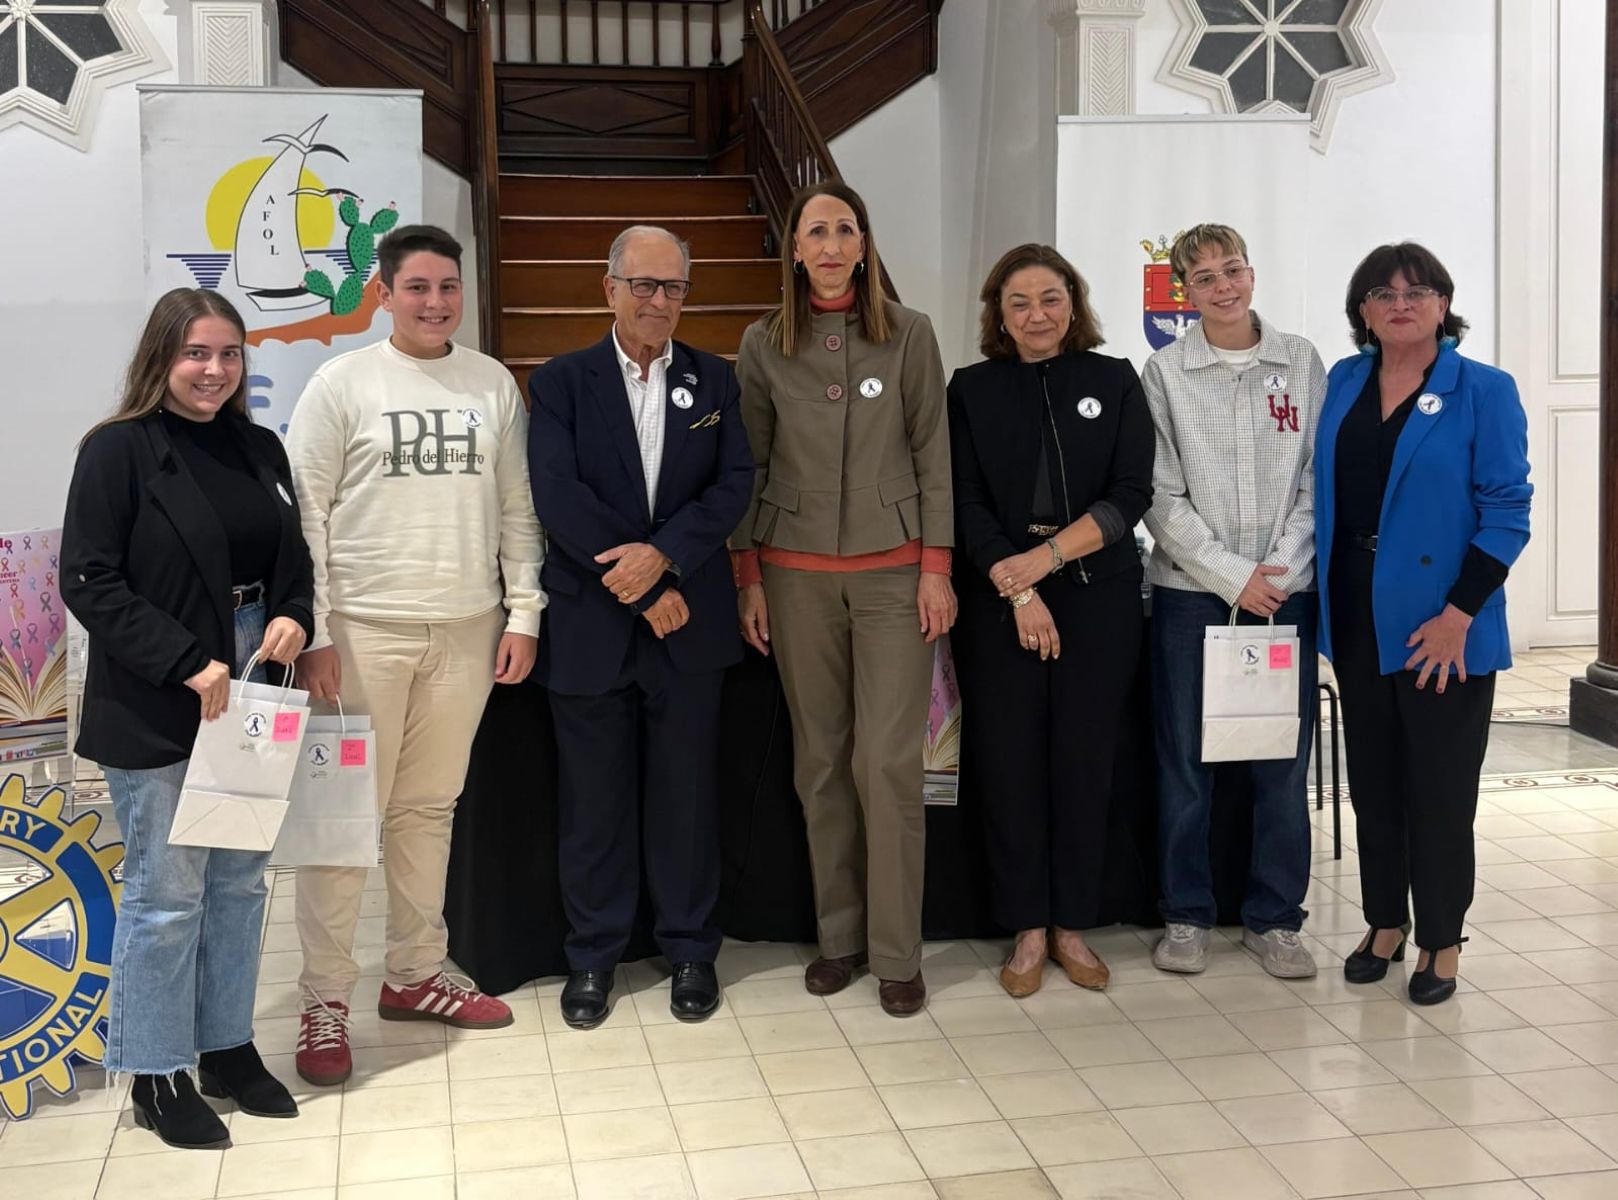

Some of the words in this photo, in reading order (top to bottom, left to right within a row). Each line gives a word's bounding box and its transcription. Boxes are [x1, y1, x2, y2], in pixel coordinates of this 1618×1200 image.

[263, 195, 279, 255] AFOL
[382, 448, 420, 466] Pedro
[422, 449, 440, 464] del
[443, 448, 485, 465] Hierro
[0, 809, 47, 840] RY
